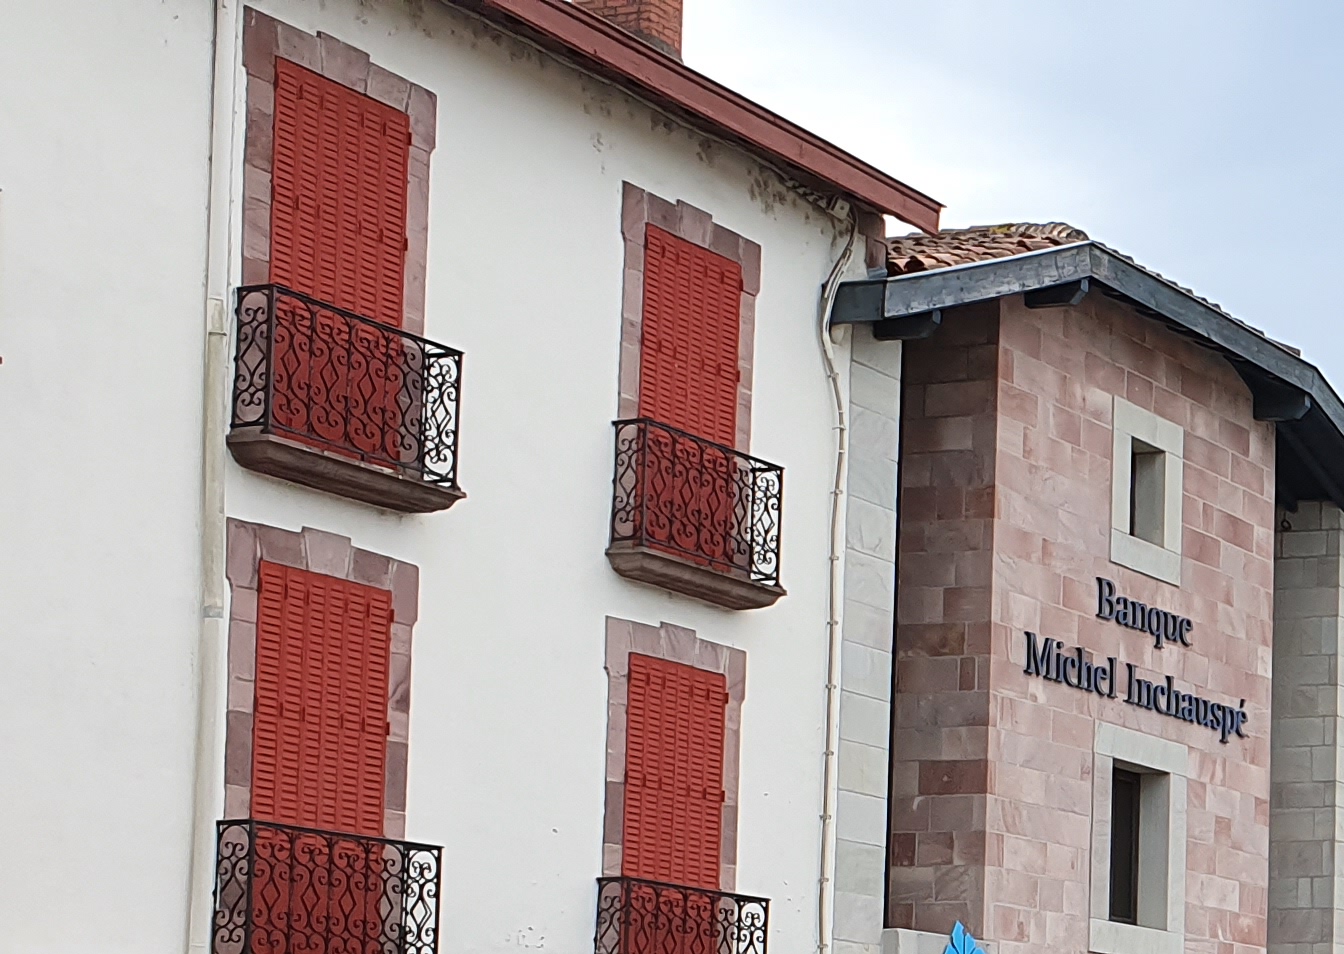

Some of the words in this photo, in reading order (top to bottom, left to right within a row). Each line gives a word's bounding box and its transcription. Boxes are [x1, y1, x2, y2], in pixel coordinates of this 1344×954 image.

[1095, 576, 1194, 649] Banque
[1023, 631, 1118, 699] Michel
[1123, 663, 1250, 744] Inchauspé
